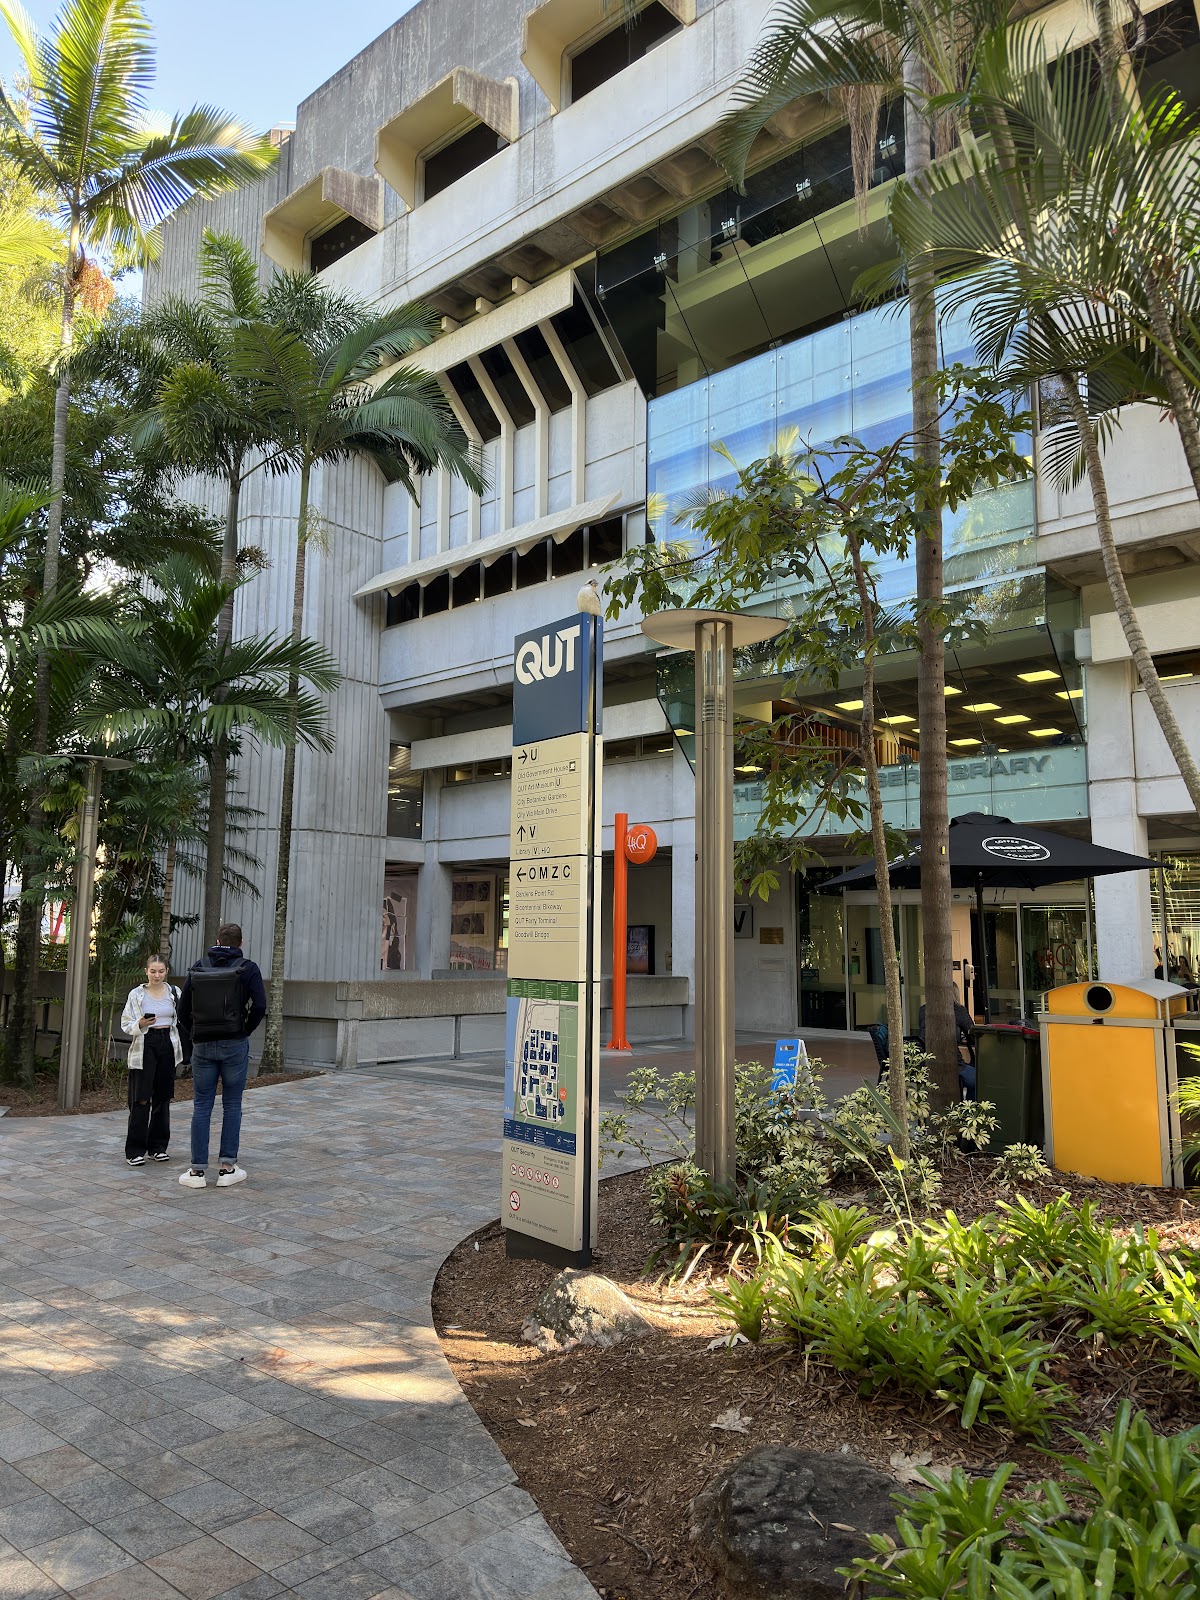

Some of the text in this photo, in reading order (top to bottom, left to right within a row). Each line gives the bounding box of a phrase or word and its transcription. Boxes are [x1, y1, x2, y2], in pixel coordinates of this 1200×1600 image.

[516, 624, 580, 685] QUT
[530, 748, 538, 760] U
[526, 767, 553, 778] Government
[554, 764, 568, 772] House
[518, 784, 526, 792] QUT
[535, 781, 554, 790] Museum
[556, 778, 561, 787] U
[517, 792, 568, 806] City Botanical Gardens
[516, 812, 526, 820] City
[530, 826, 536, 838] V
[516, 847, 530, 856] Library
[529, 865, 570, 880] O M Z C
[534, 931, 550, 939] Bridge
[520, 1149, 536, 1159] Security
